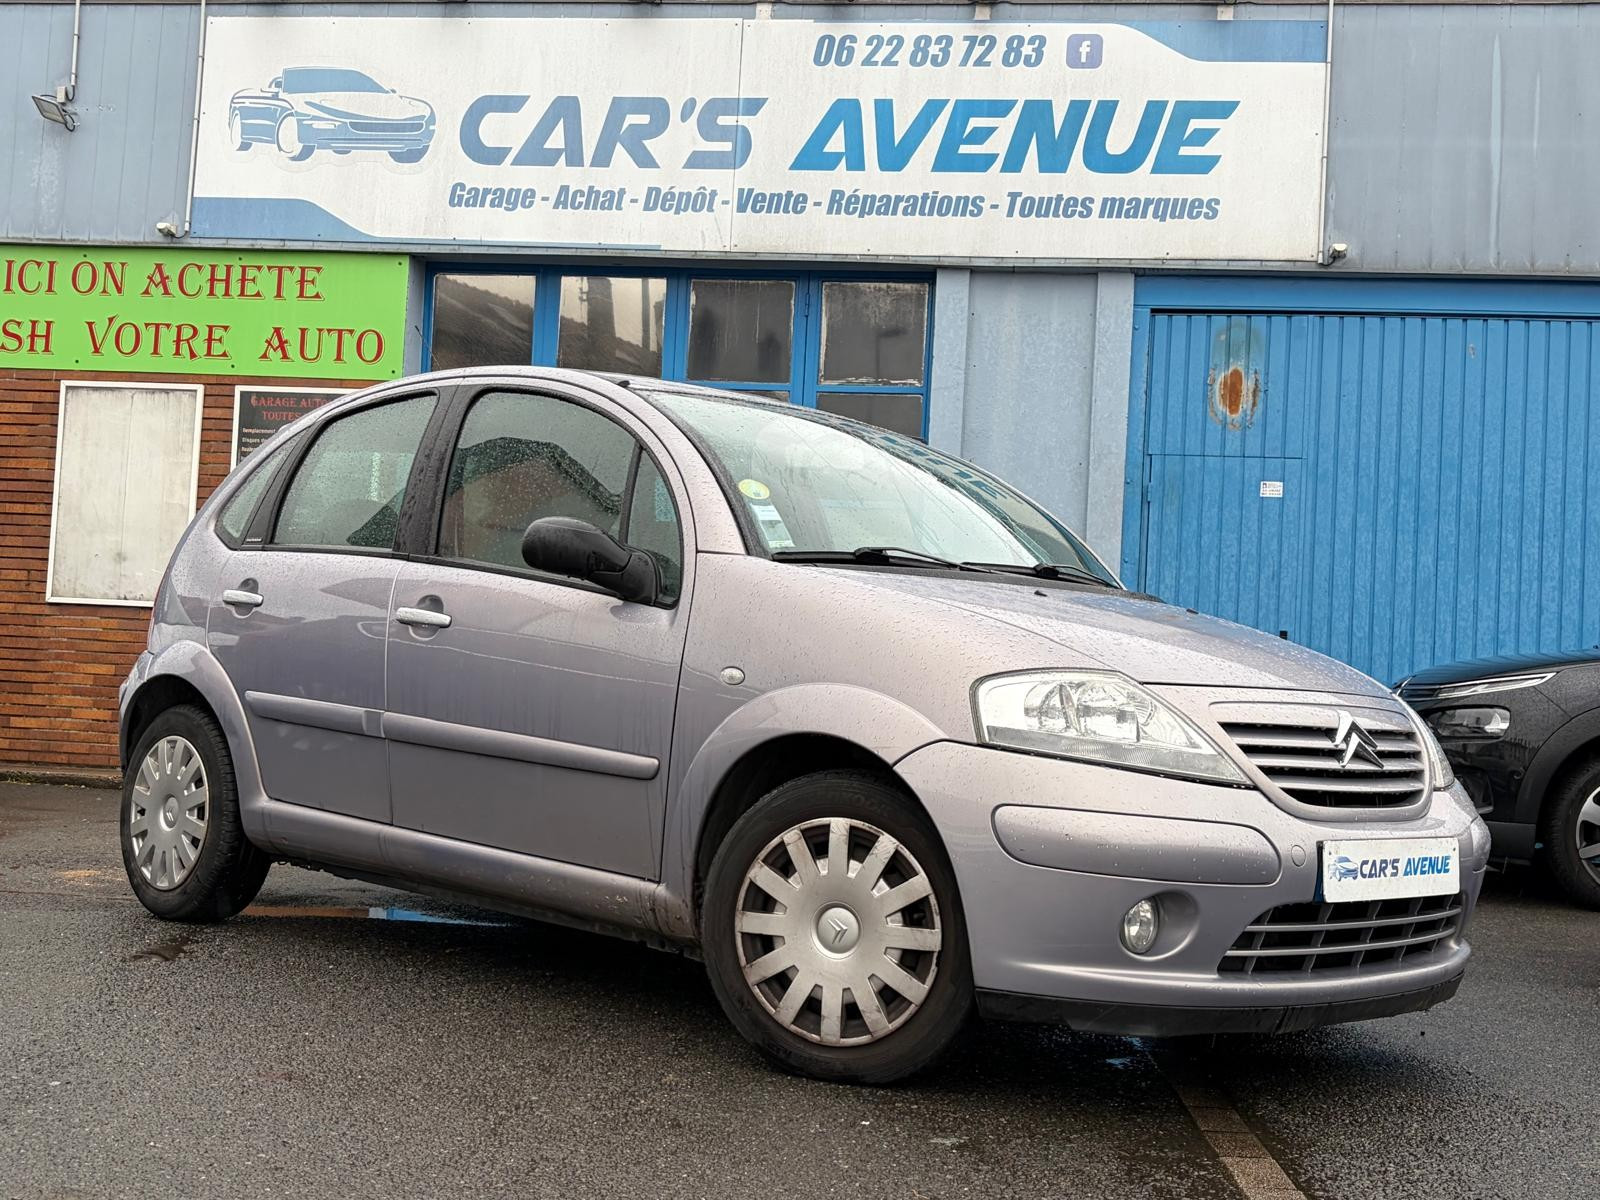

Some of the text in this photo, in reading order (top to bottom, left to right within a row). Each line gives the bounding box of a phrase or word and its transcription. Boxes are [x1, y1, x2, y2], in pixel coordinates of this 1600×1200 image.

[813, 34, 1047, 68] 06 22 83 72 83
[459, 95, 1240, 175] CAR'S AVENUE
[449, 182, 536, 211] Garage
[552, 184, 627, 211] Achat
[643, 186, 718, 215] Dépôt
[735, 187, 808, 215] Vente
[826, 188, 985, 218] Réparations
[1005, 191, 1094, 219] Toutes
[1098, 196, 1221, 222] marques
[3, 260, 324, 301] ICI ON ACHETE
[0, 314, 385, 365] SH VOTRE AUTO
[250, 393, 297, 408] GARAGE
[262, 411, 301, 421] TOUTES
[1359, 855, 1451, 879] CAR'S AVENUE
